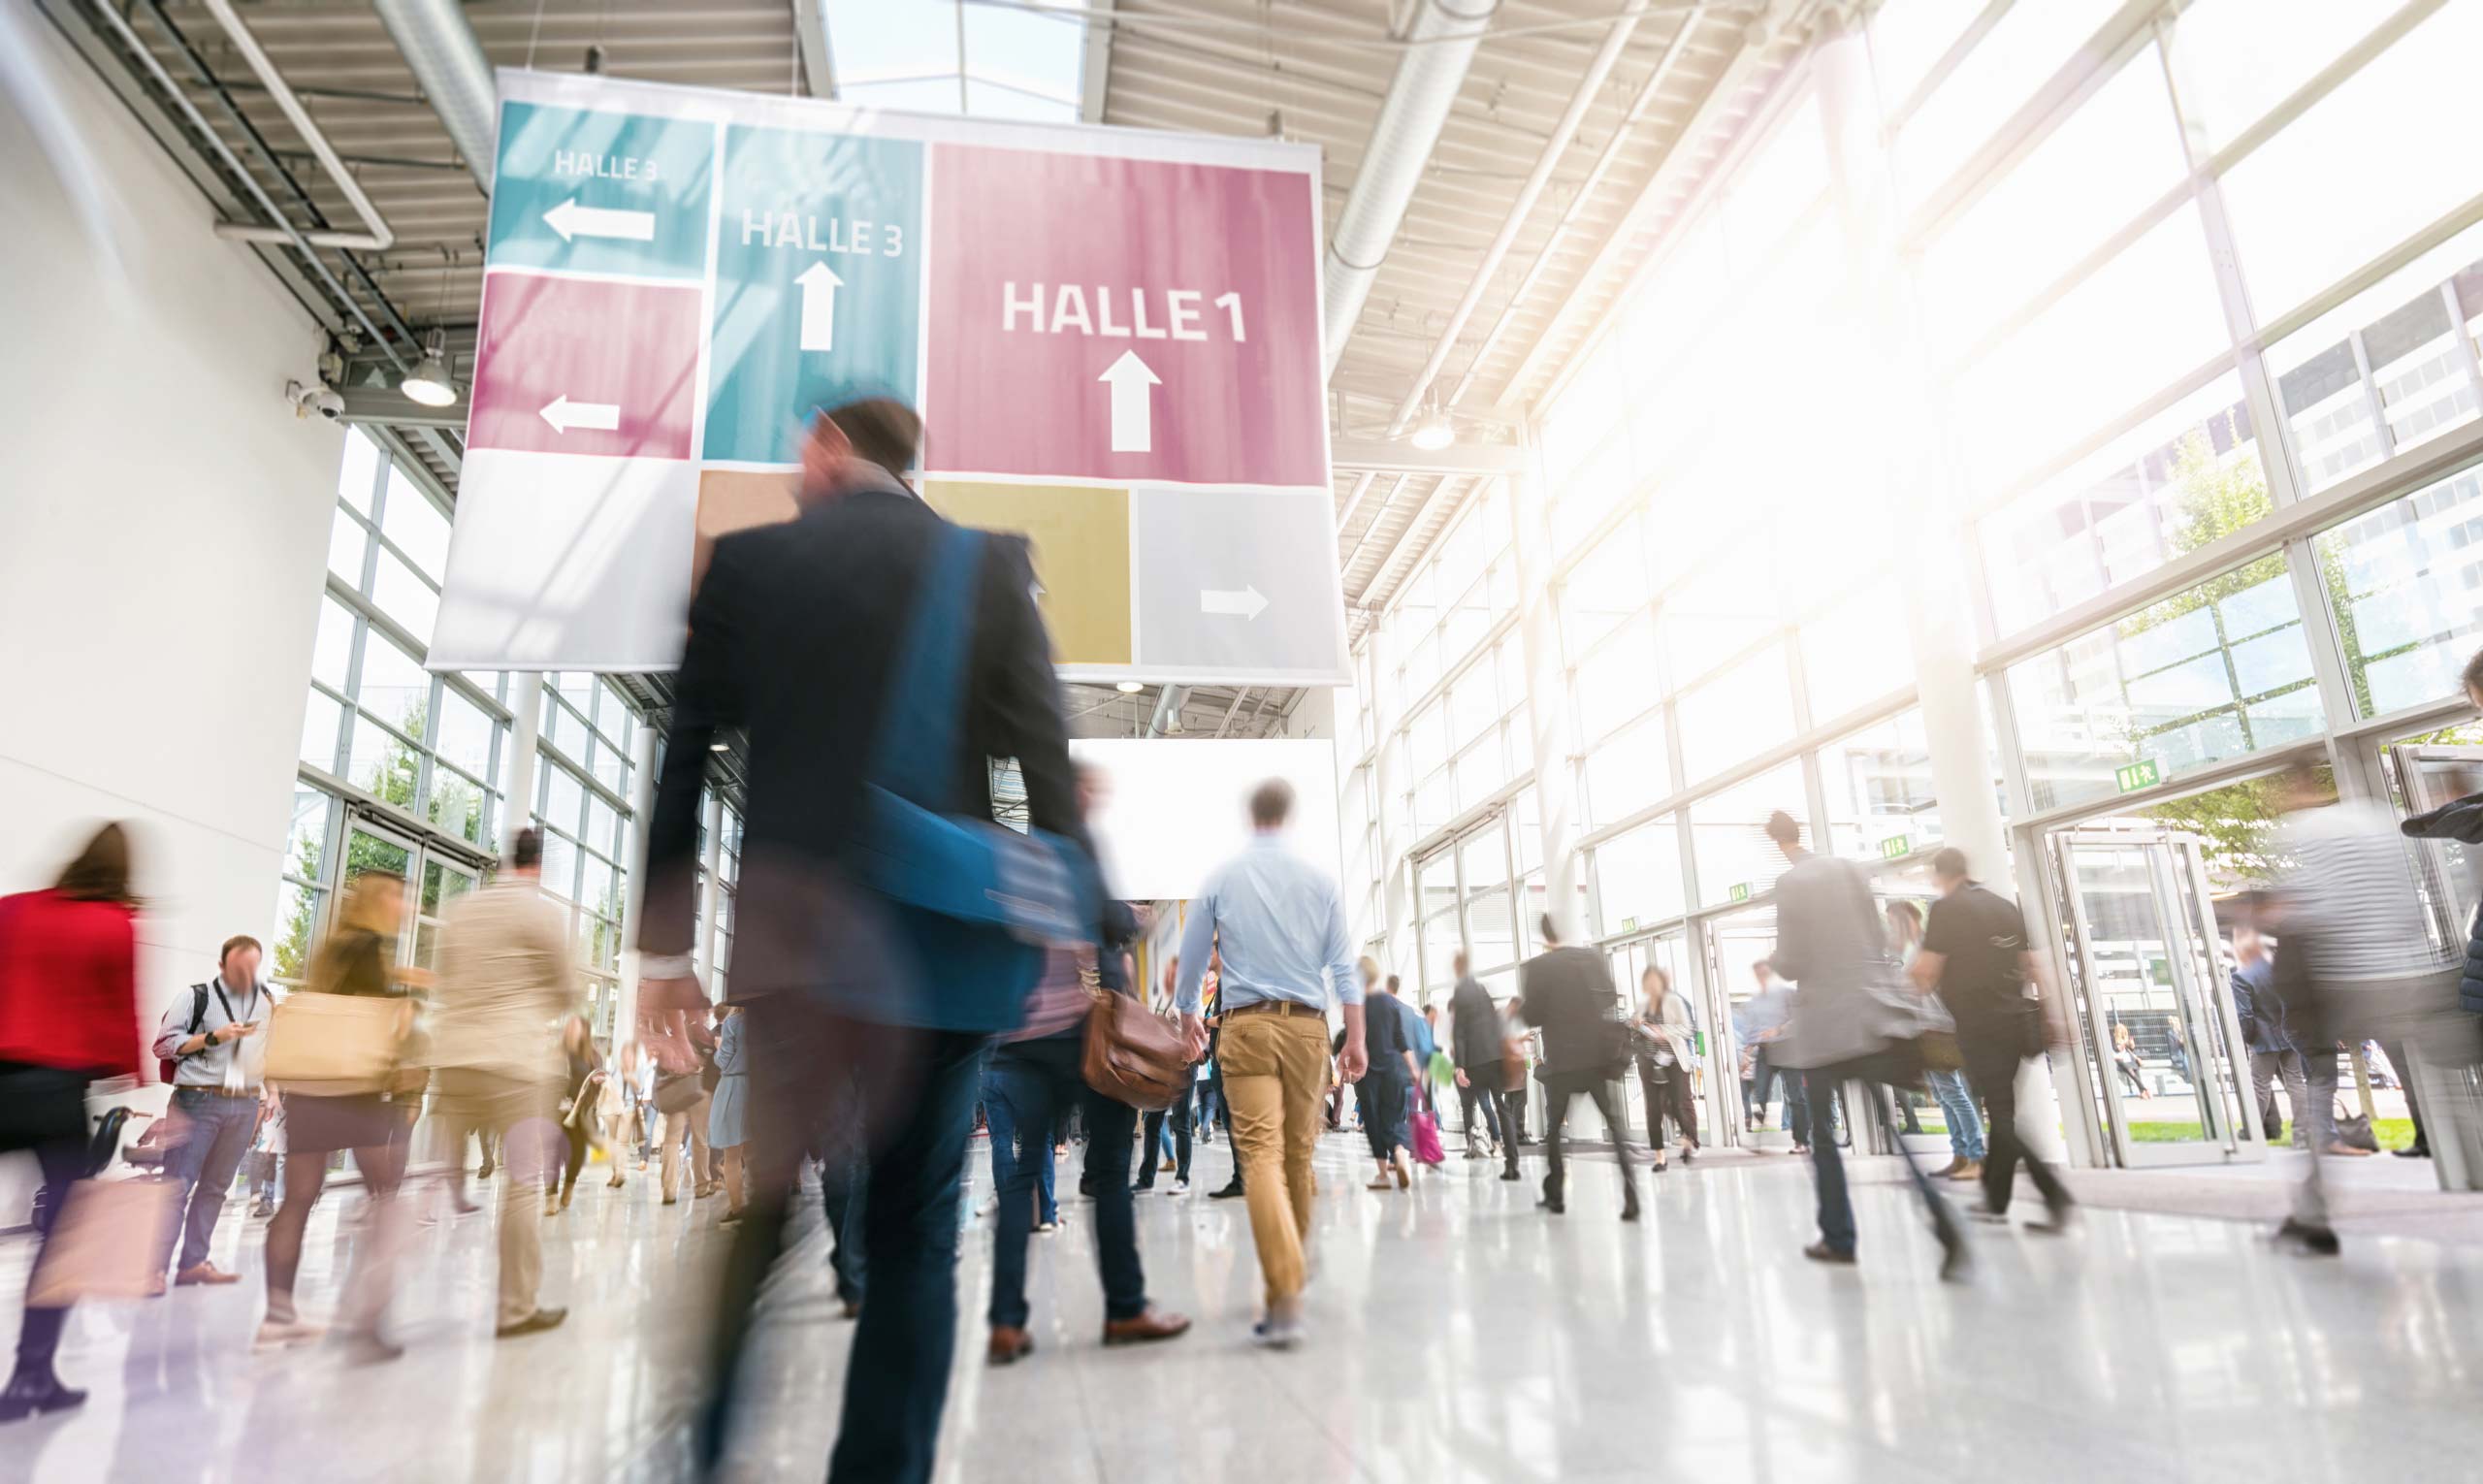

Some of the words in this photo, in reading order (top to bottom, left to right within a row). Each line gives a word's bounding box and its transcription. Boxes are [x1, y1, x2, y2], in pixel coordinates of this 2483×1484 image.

[554, 149, 638, 180] HALLE
[644, 159, 658, 181] 3
[742, 208, 873, 255] HALLE
[883, 224, 903, 258] 3
[1002, 281, 1209, 342] HALLE
[1213, 291, 1246, 342] 1
